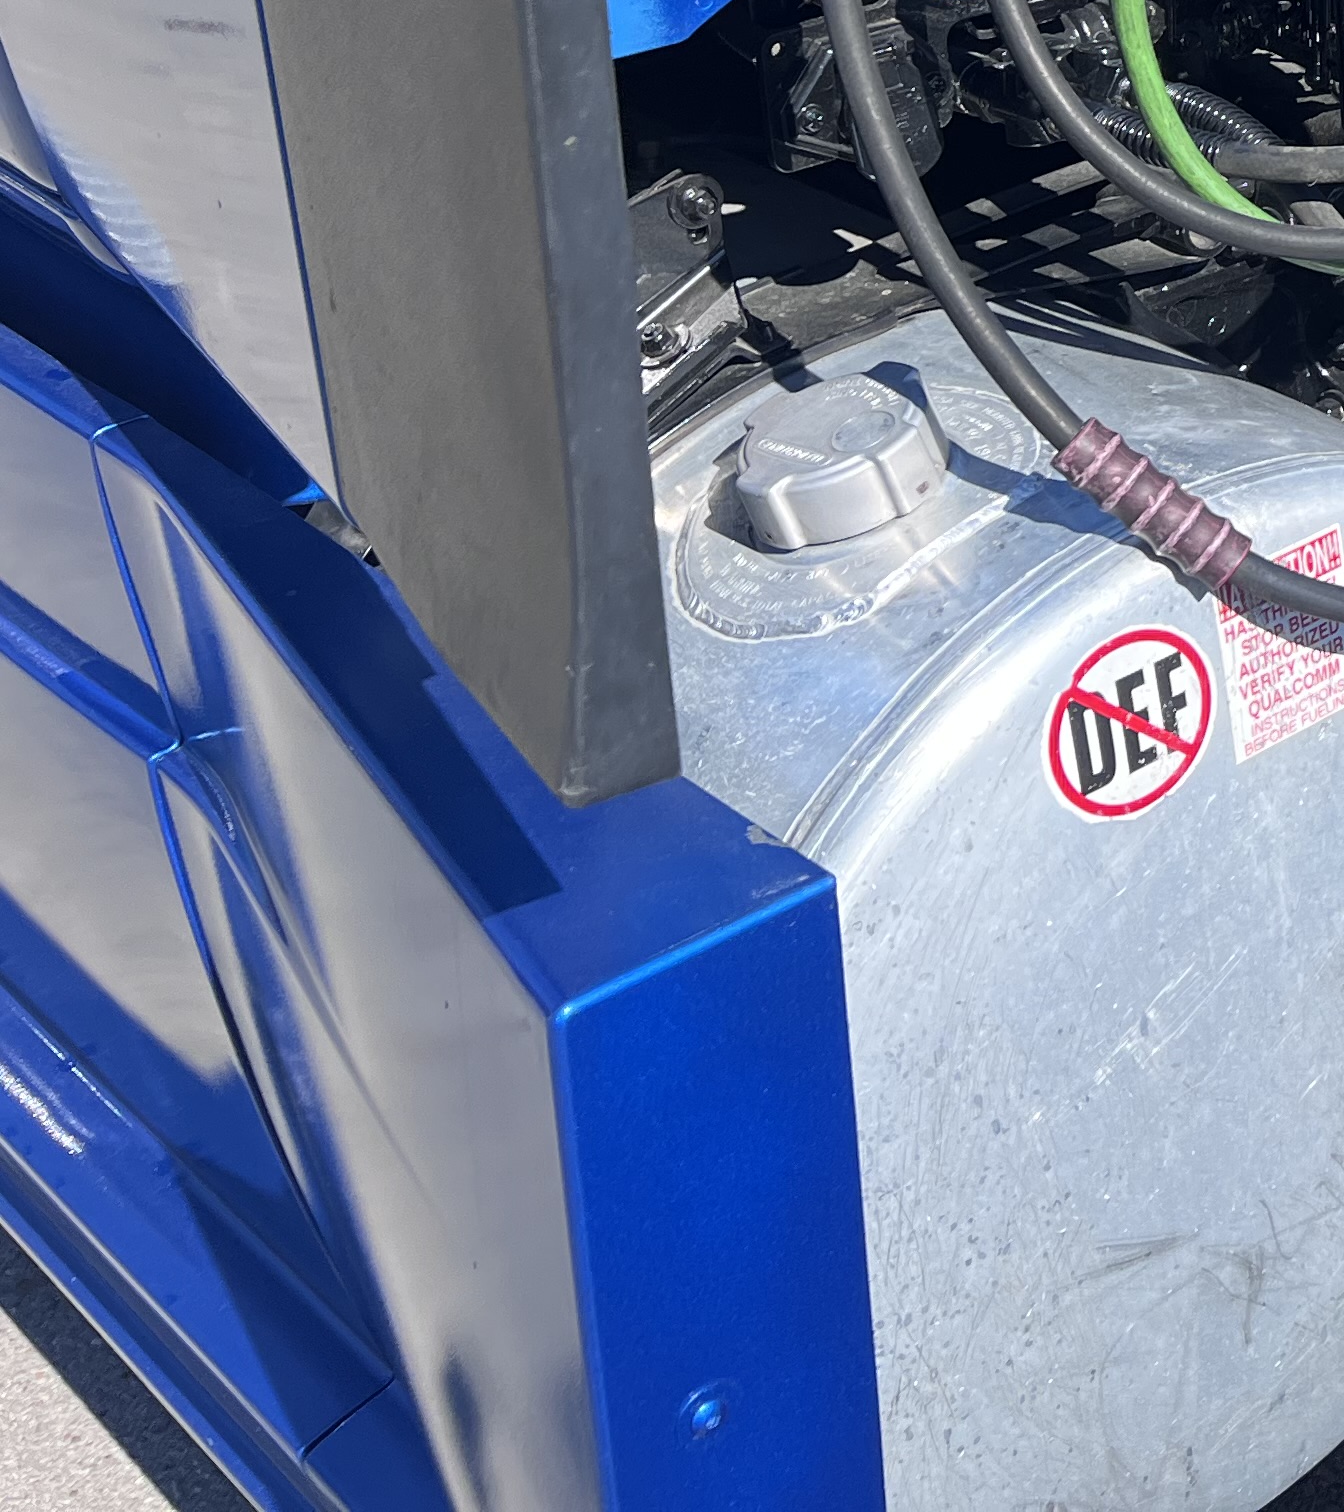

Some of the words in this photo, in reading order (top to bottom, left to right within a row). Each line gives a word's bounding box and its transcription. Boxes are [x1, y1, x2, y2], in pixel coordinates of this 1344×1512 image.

[1242, 623, 1284, 656] STOP
[1261, 603, 1293, 624] THI
[1238, 660, 1297, 700] VERIFY
[1302, 635, 1344, 667] YOUR
[1239, 621, 1340, 681] AUTHORIZED
[1248, 658, 1341, 720] QUALCOMM
[1068, 651, 1188, 797] DEF
[1244, 719, 1299, 757] BEFORE
